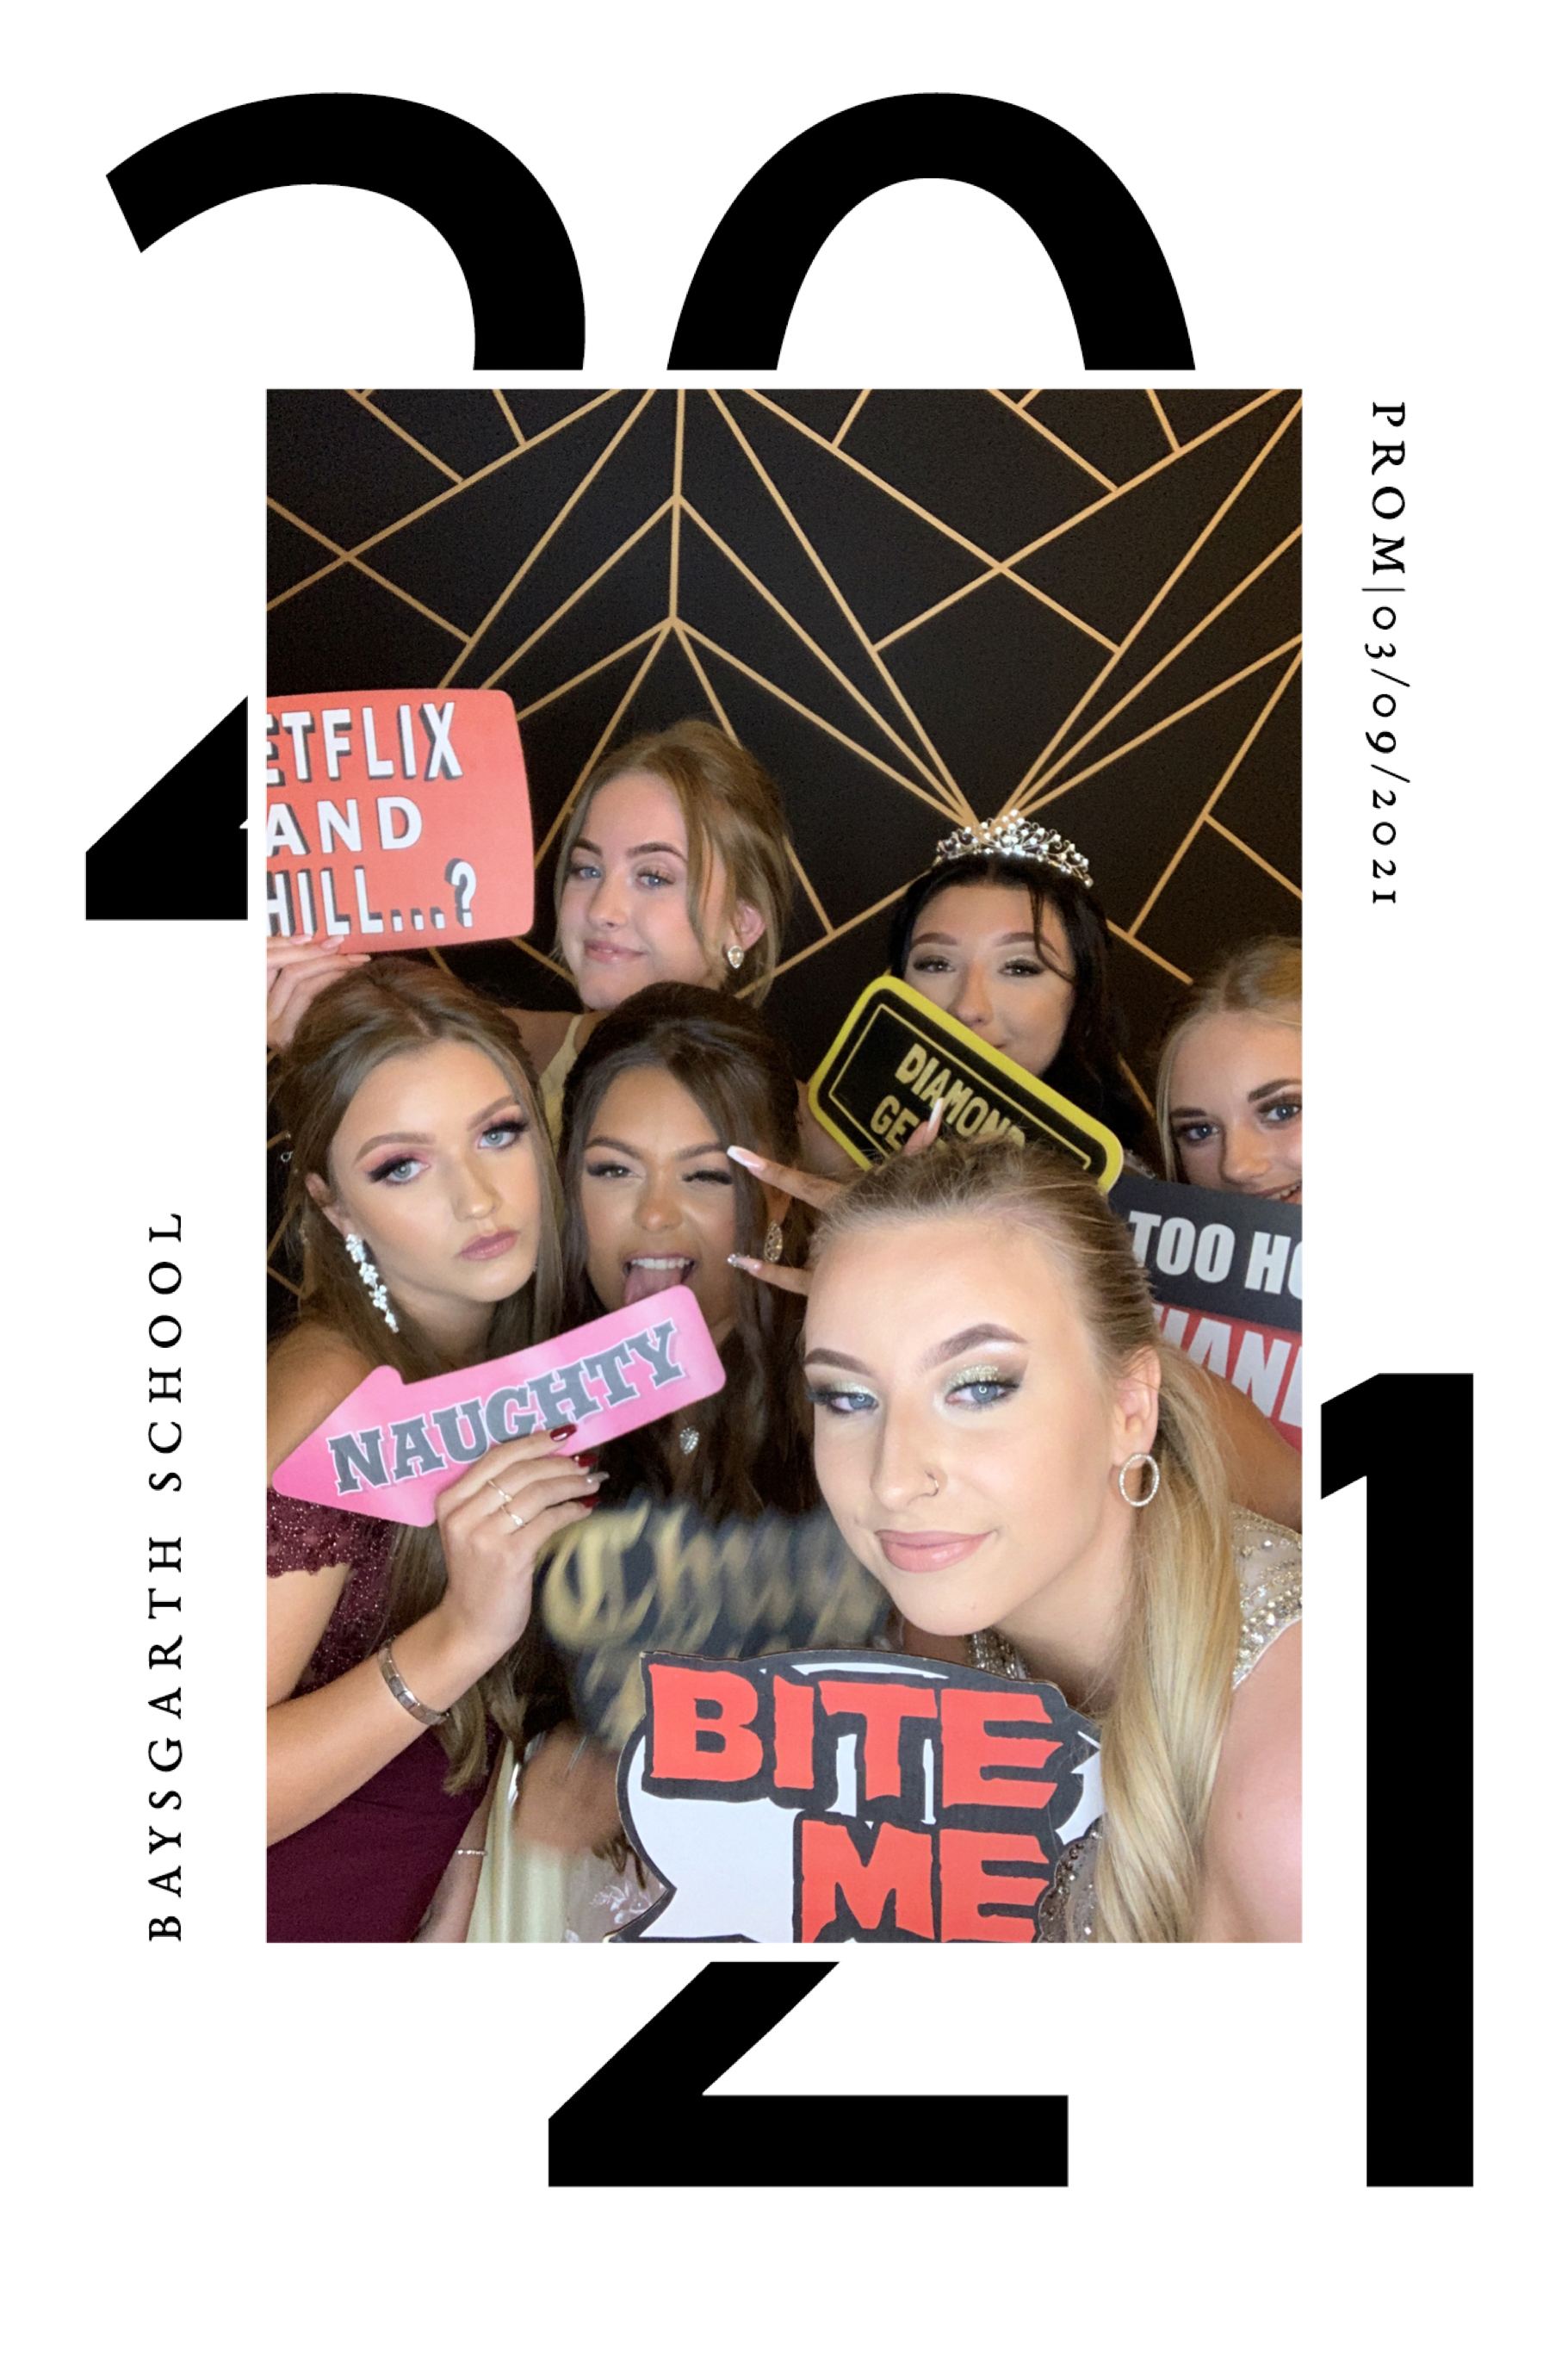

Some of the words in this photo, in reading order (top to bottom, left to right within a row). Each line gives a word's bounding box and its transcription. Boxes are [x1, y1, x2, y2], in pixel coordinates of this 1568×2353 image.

[267, 796, 423, 858] AND
[1128, 1209, 1236, 1283] TOO
[325, 1318, 688, 1497] NAUGHTY
[648, 1663, 1064, 1810] BITE
[799, 1819, 1052, 1944] ME
